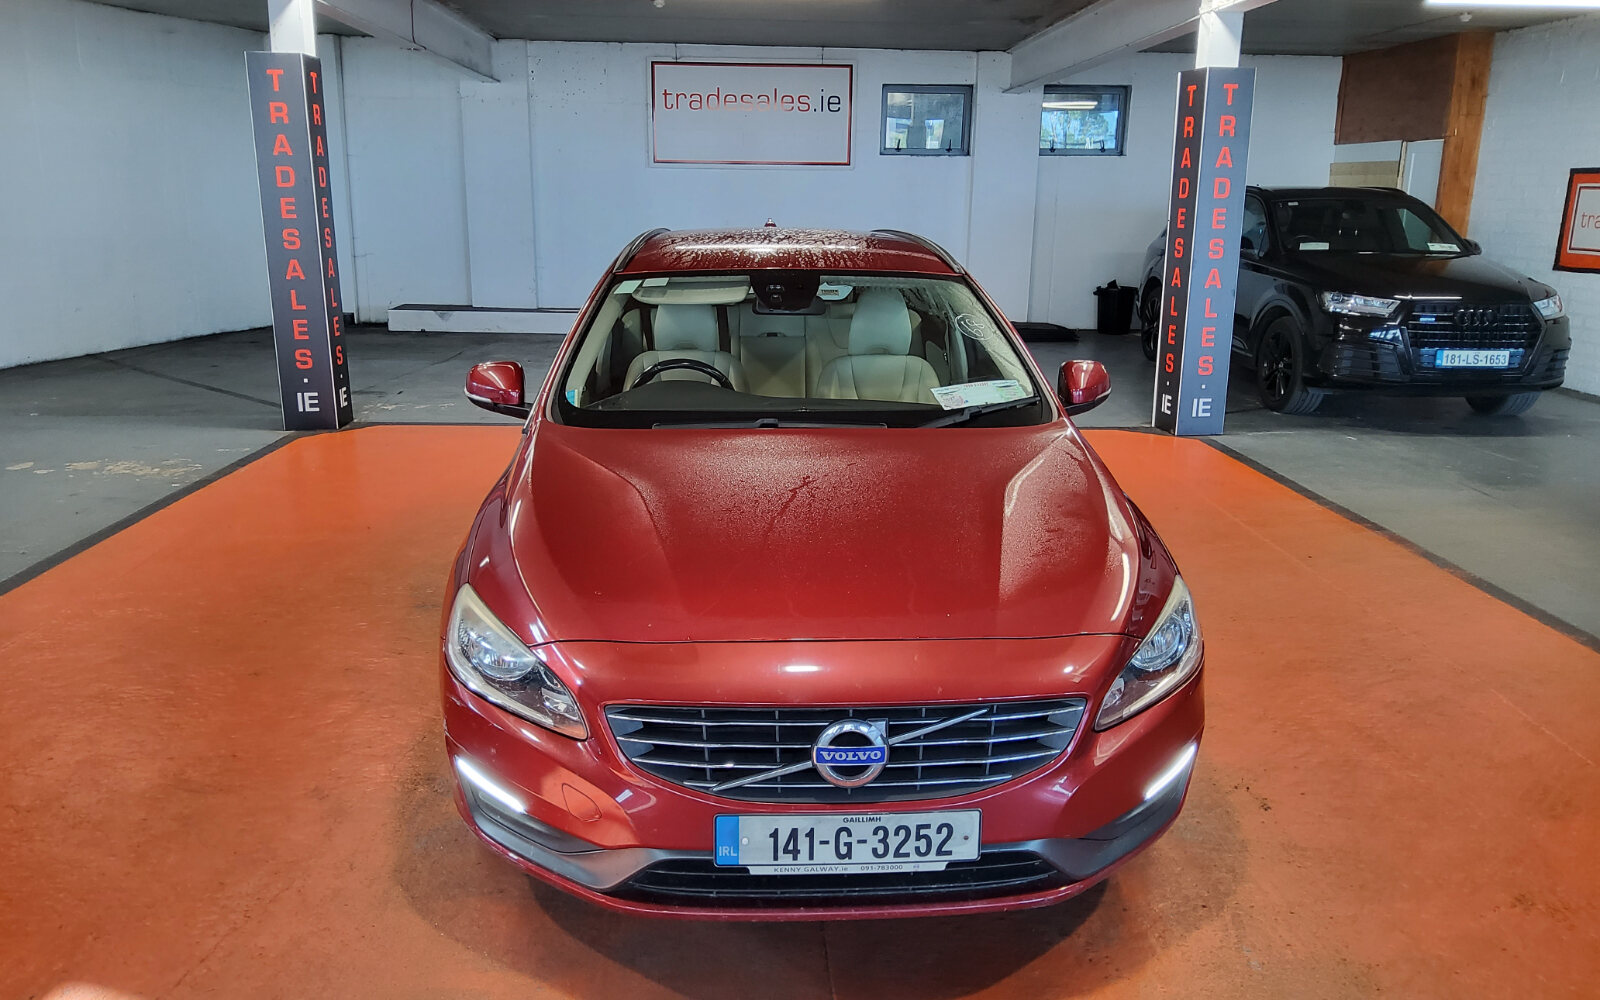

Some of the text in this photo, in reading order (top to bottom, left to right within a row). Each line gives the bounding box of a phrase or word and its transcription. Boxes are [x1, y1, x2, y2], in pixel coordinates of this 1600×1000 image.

[662, 87, 841, 112] tradesales.ie
[1444, 353, 1507, 365] 181-LS-1653
[820, 750, 882, 761] VOLVO
[768, 822, 954, 862] 141-G-3252
[718, 846, 737, 857] IRL
